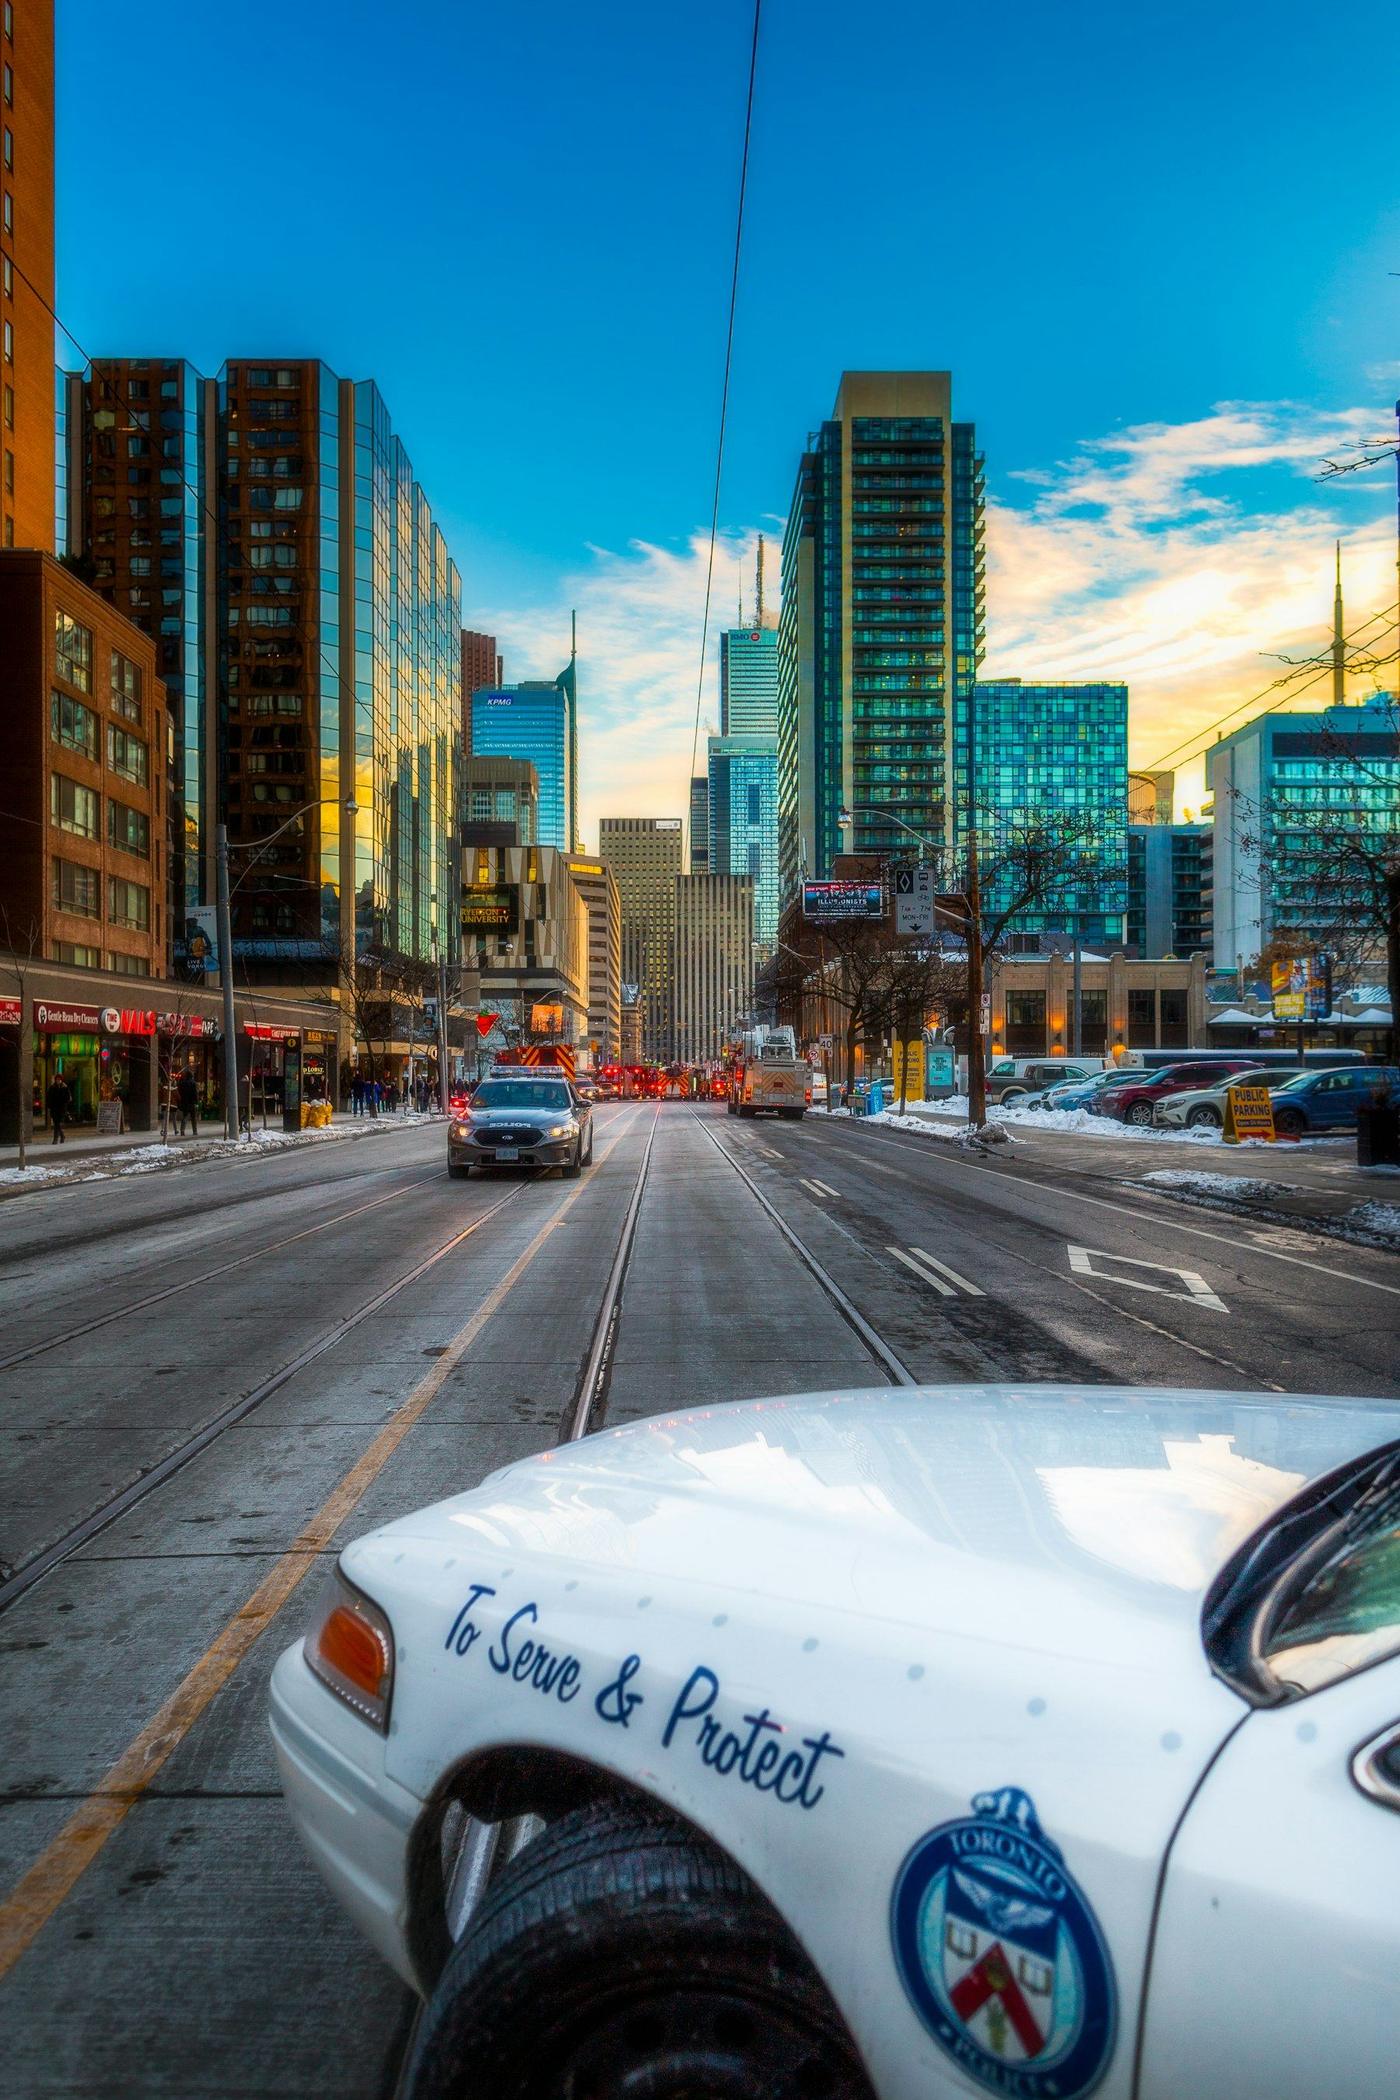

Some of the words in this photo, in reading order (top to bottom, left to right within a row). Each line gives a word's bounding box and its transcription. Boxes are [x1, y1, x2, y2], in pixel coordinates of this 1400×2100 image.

[488, 698, 512, 706] KPMG
[81, 1013, 98, 1024] Cleaners
[120, 1009, 157, 1035] NAILS
[820, 1040, 832, 1048] 40
[1235, 1090, 1264, 1101] PUBLIC
[1234, 1104, 1270, 1115] PARKING
[444, 1584, 496, 1656] To
[488, 1602, 582, 1702] Serve
[594, 1653, 643, 1728] &
[662, 1665, 845, 1809] Protect
[949, 1828, 1067, 1901] TORONTO
